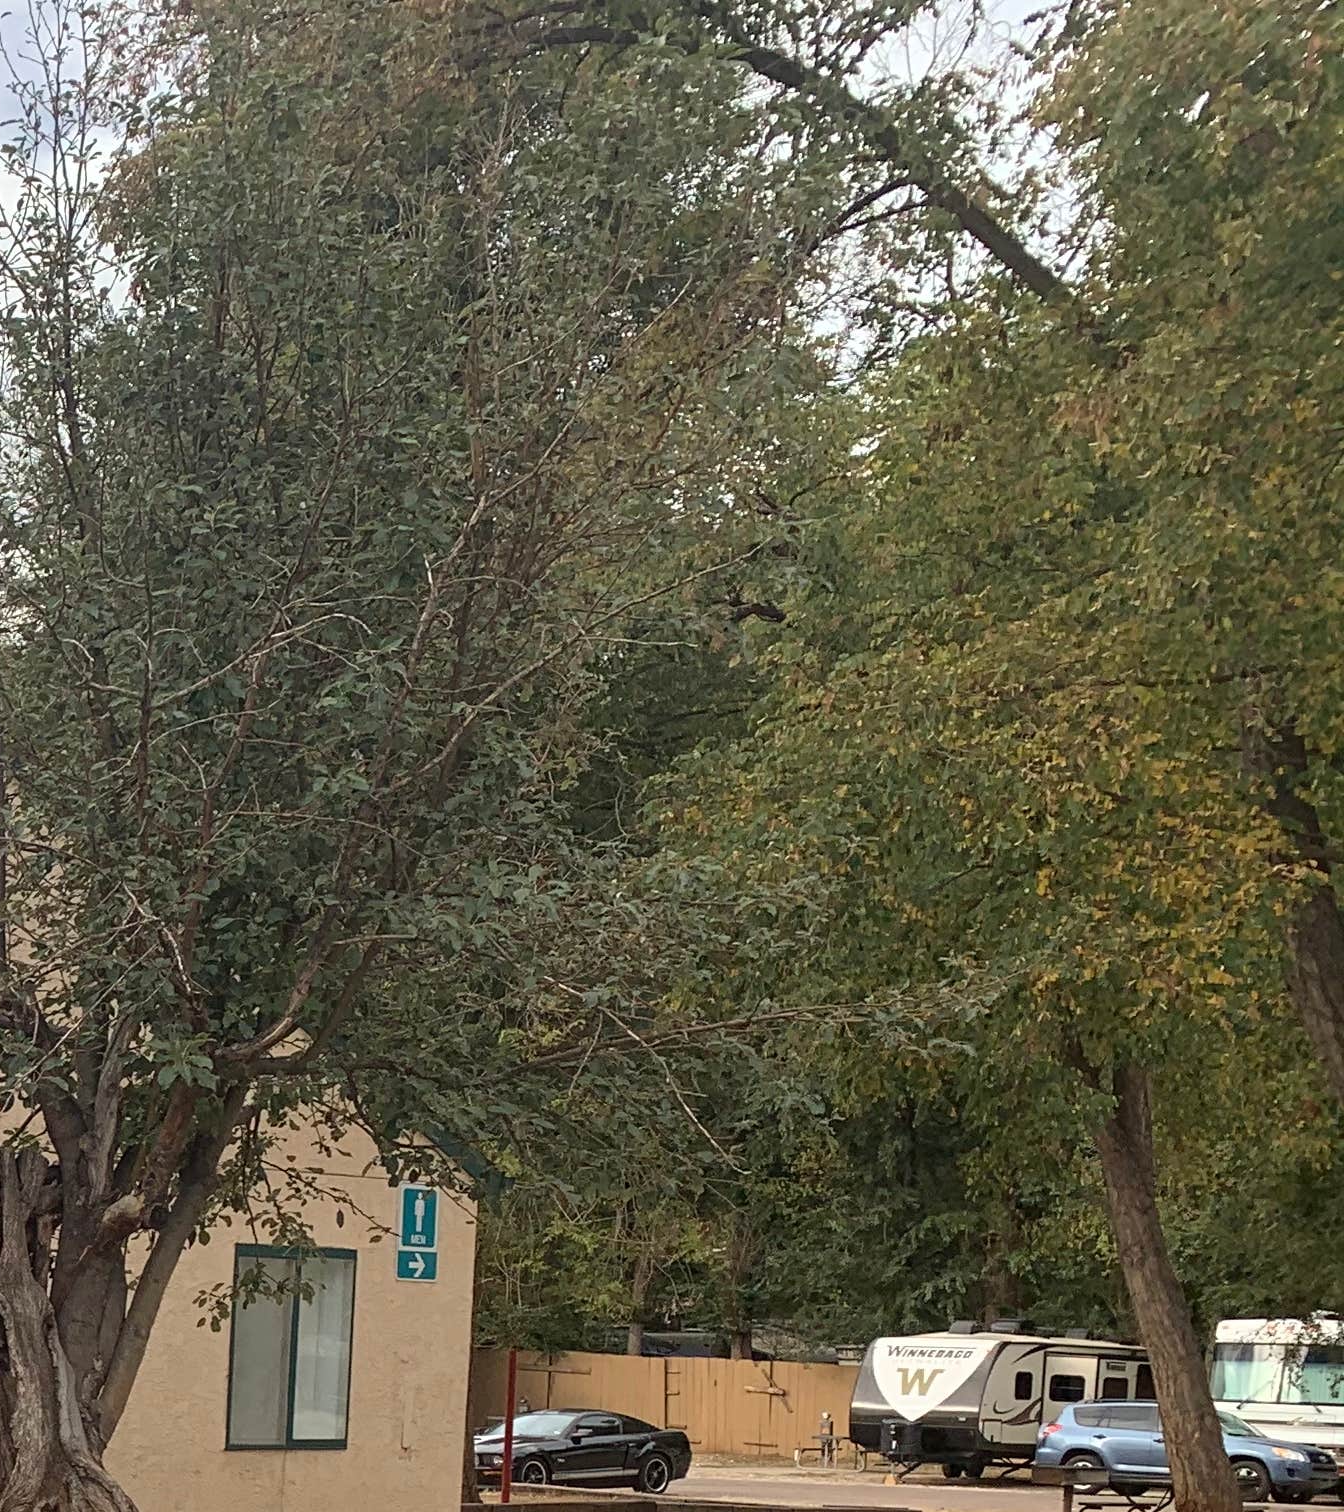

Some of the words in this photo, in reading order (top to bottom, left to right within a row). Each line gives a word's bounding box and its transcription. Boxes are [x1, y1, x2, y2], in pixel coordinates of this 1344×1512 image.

[411, 1234, 426, 1244] MEN
[887, 1345, 975, 1359] WINNEBAGO
[896, 1367, 946, 1396] W
